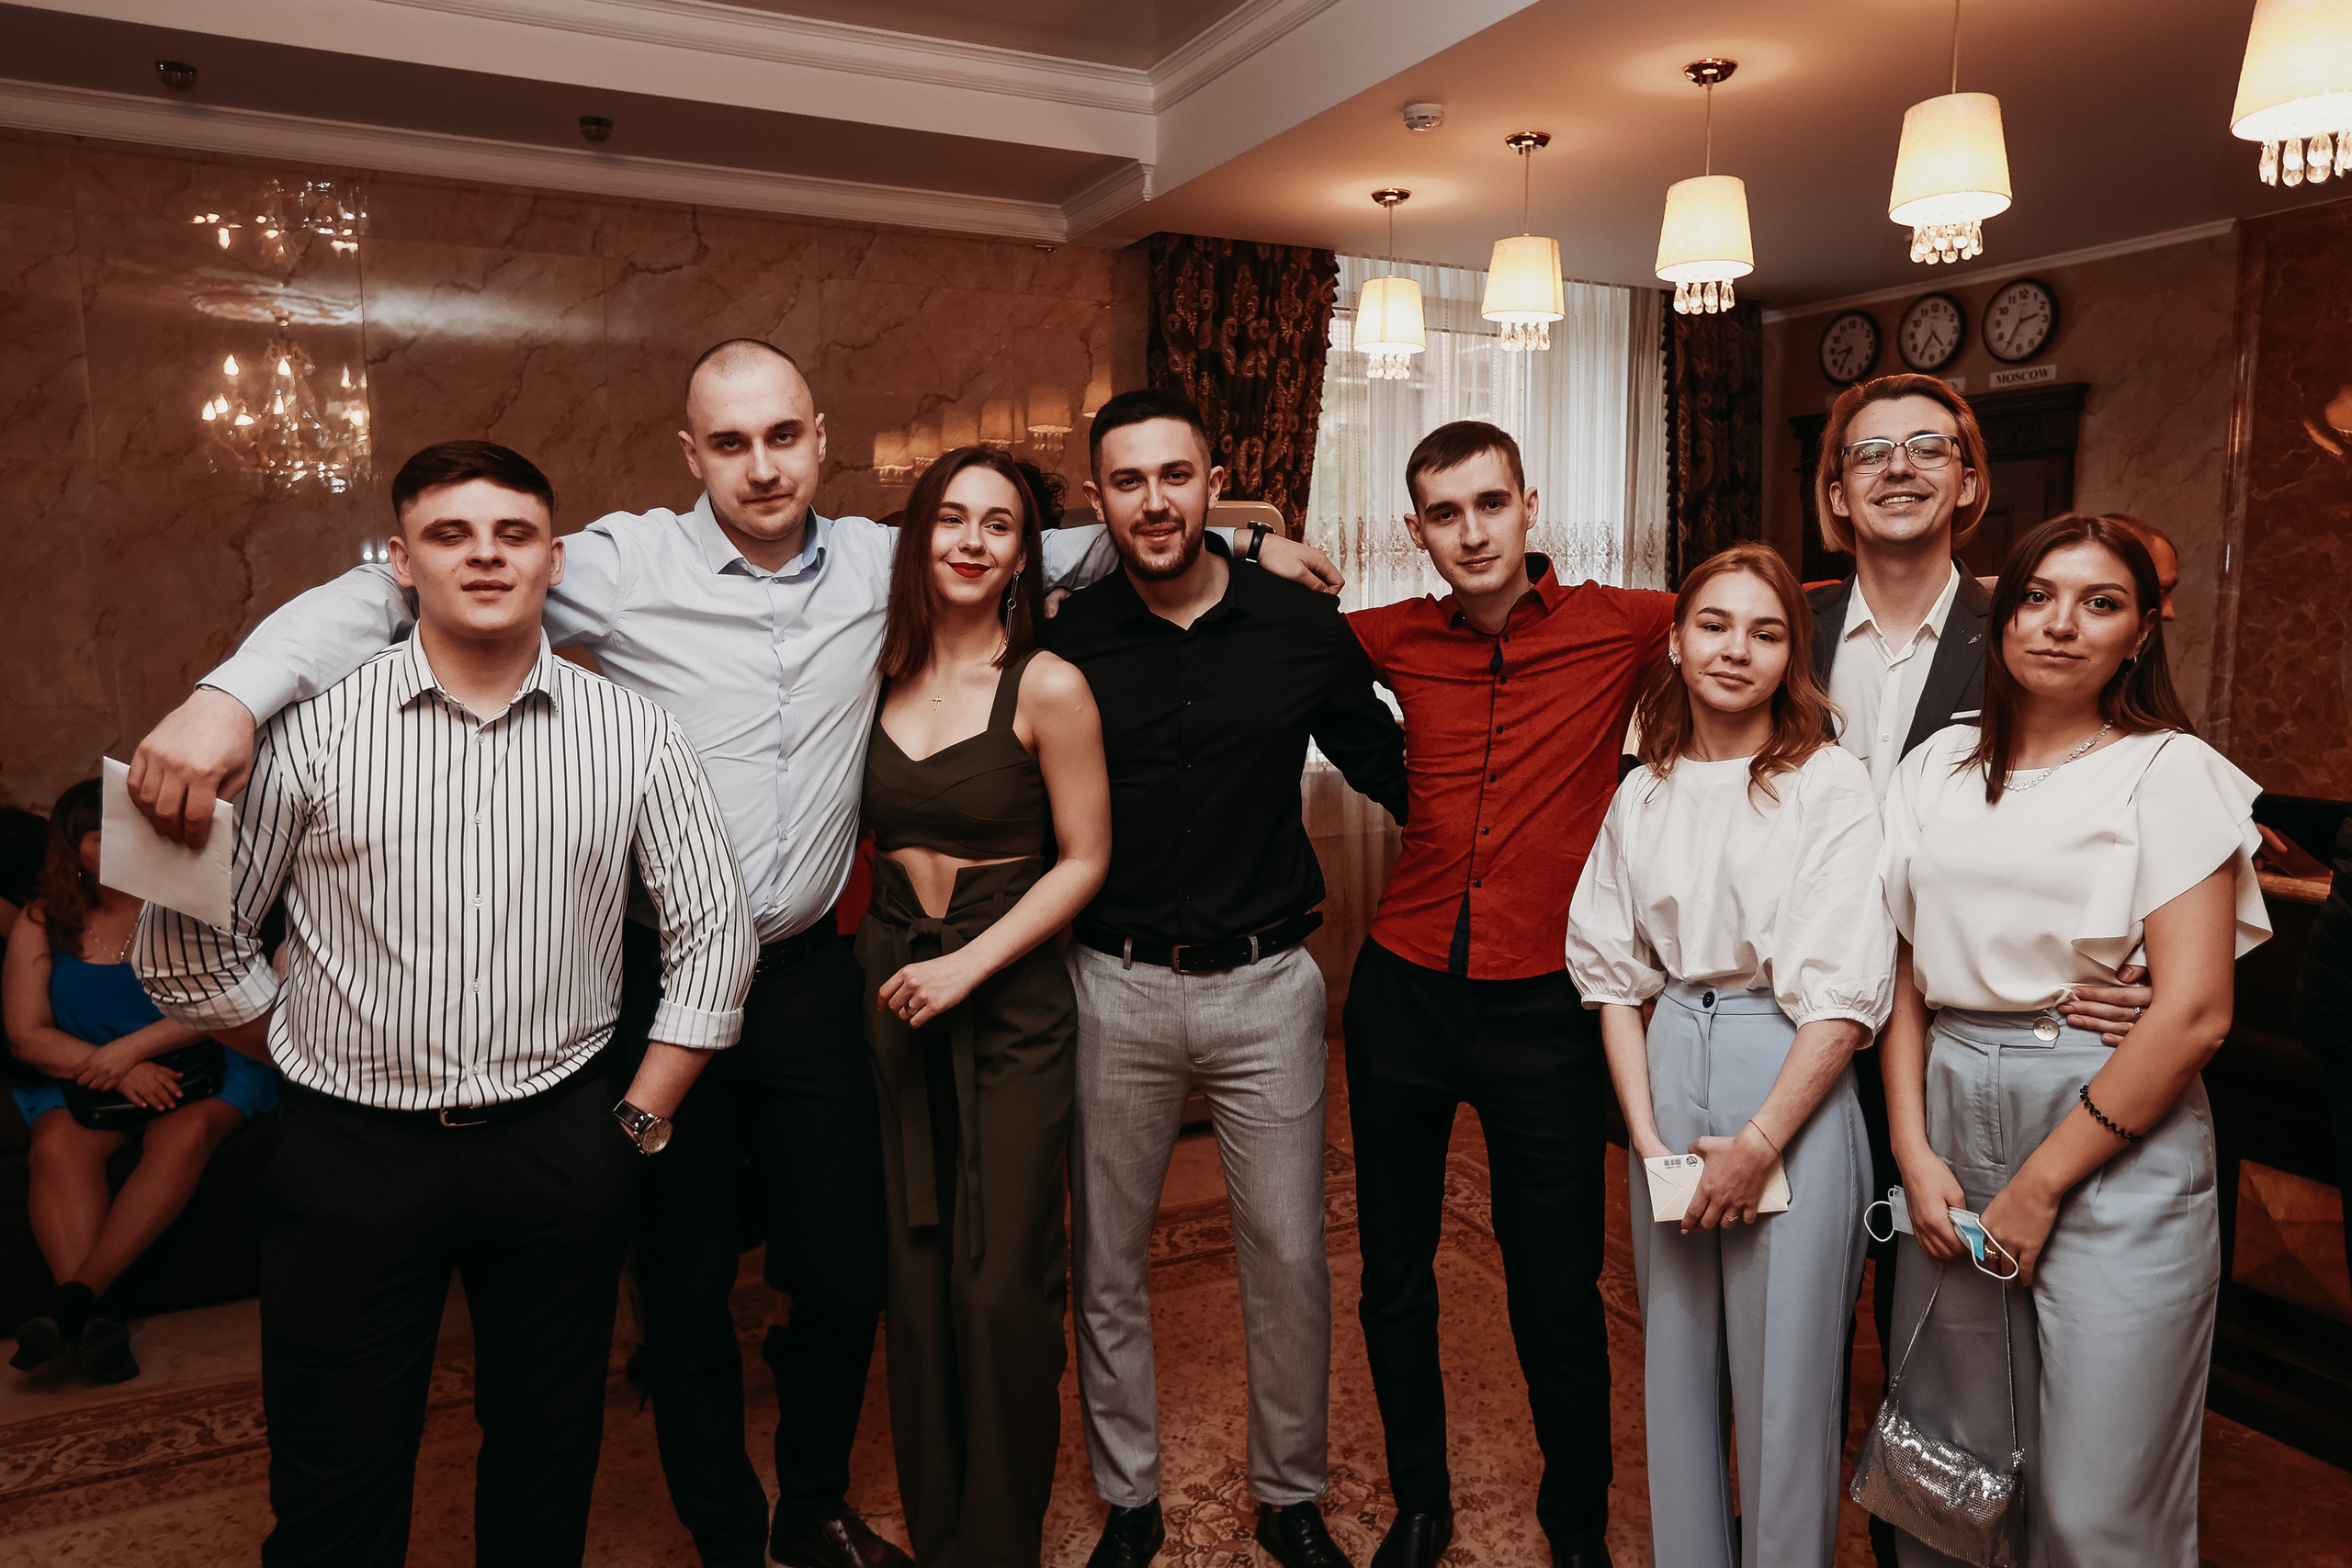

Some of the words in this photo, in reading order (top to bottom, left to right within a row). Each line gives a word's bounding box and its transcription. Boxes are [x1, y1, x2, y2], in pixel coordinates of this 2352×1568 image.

[2018, 288, 2029, 299] 12
[2033, 292, 2038, 301] 1
[2007, 295, 2017, 305] 11
[2039, 300, 2046, 310] 2
[1998, 306, 2009, 316] 10
[2041, 313, 2049, 323] 3
[1996, 367, 2049, 383] MOSCOW
